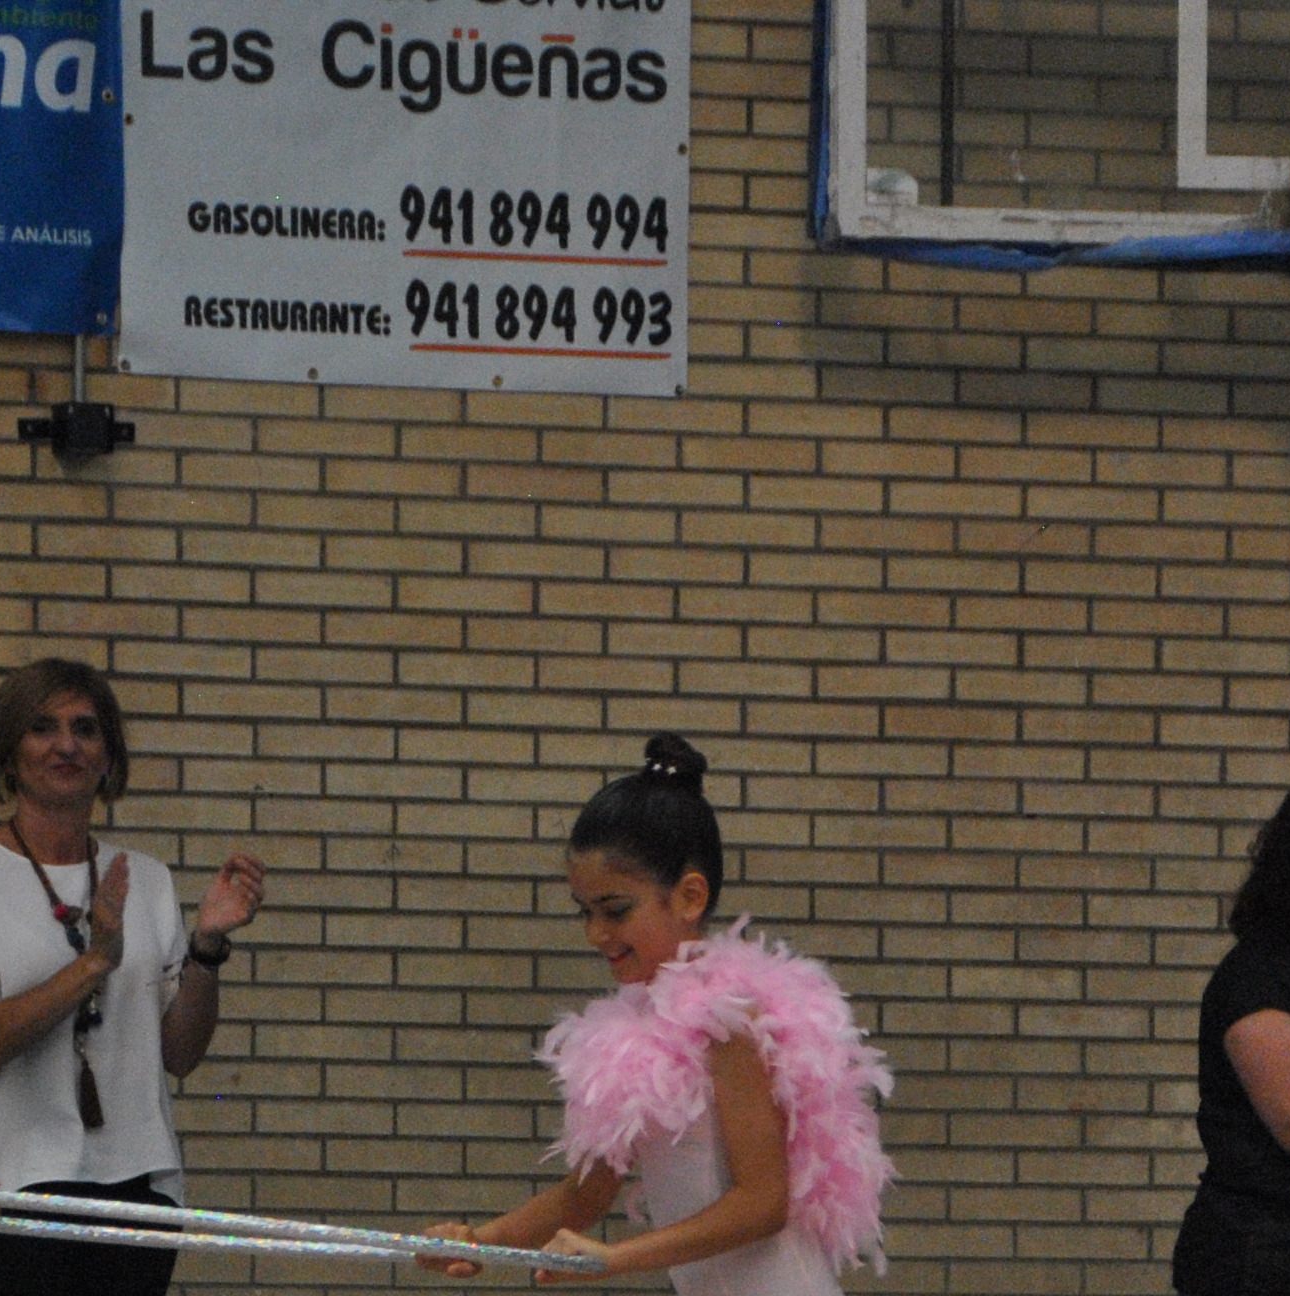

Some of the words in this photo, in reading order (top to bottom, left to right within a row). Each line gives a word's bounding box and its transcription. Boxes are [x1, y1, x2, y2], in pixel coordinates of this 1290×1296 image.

[139, 9, 275, 84] Las
[320, 18, 668, 114] Cigüeñas
[186, 201, 386, 243] GASOLINERA:
[400, 183, 476, 246] 941
[489, 189, 571, 250] 894
[585, 193, 669, 254] 994
[183, 294, 393, 338] RESTAURANTE:
[404, 278, 481, 340] 941
[494, 283, 578, 344] 894
[592, 287, 674, 347] 993
